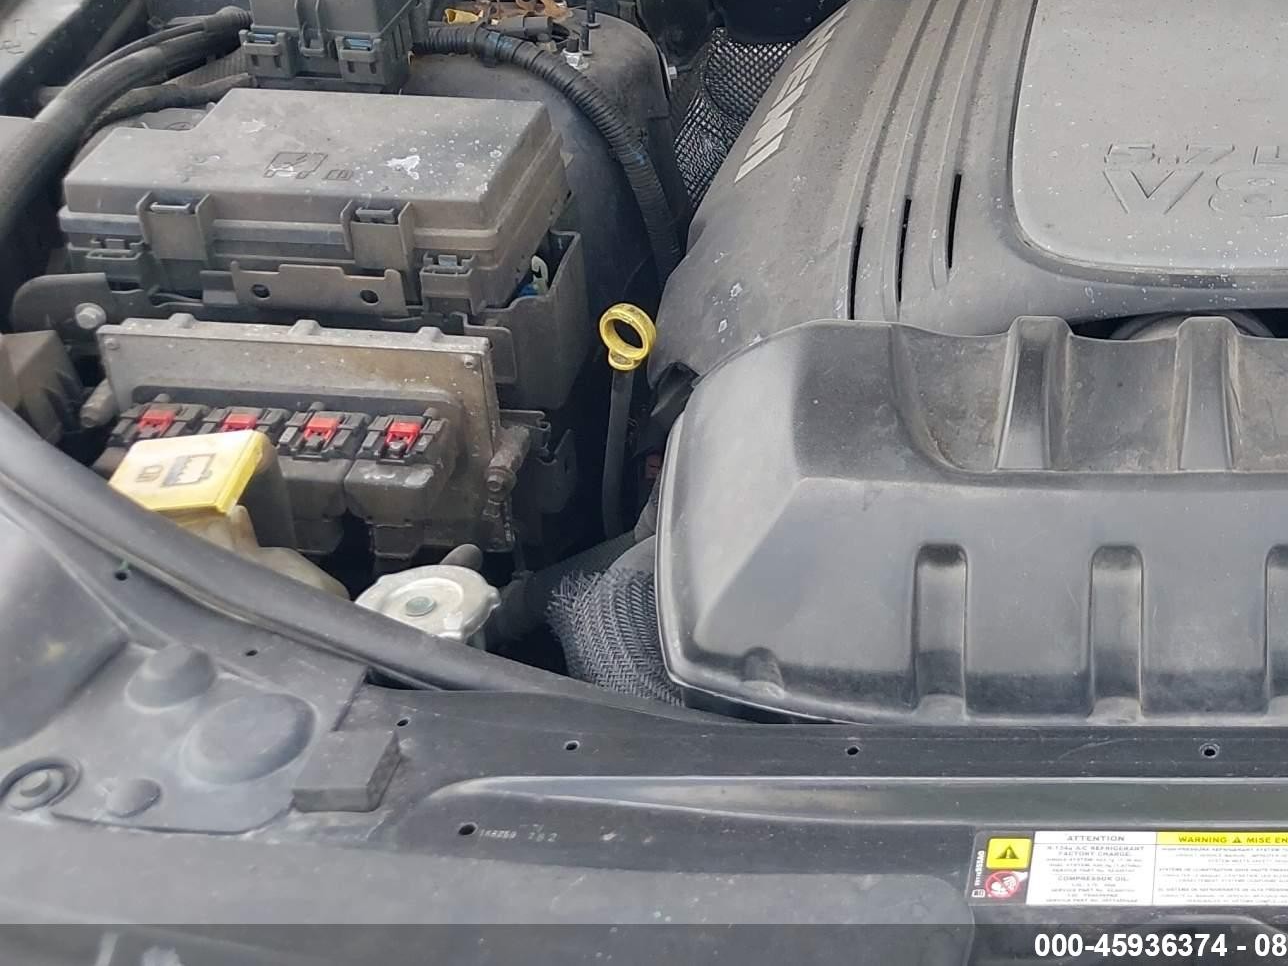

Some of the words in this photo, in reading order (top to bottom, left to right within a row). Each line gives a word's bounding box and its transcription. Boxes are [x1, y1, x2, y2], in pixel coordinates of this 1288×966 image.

[1178, 836, 1228, 844] WARNING
[1246, 836, 1272, 844] MISE
[1275, 836, 1288, 844] EN
